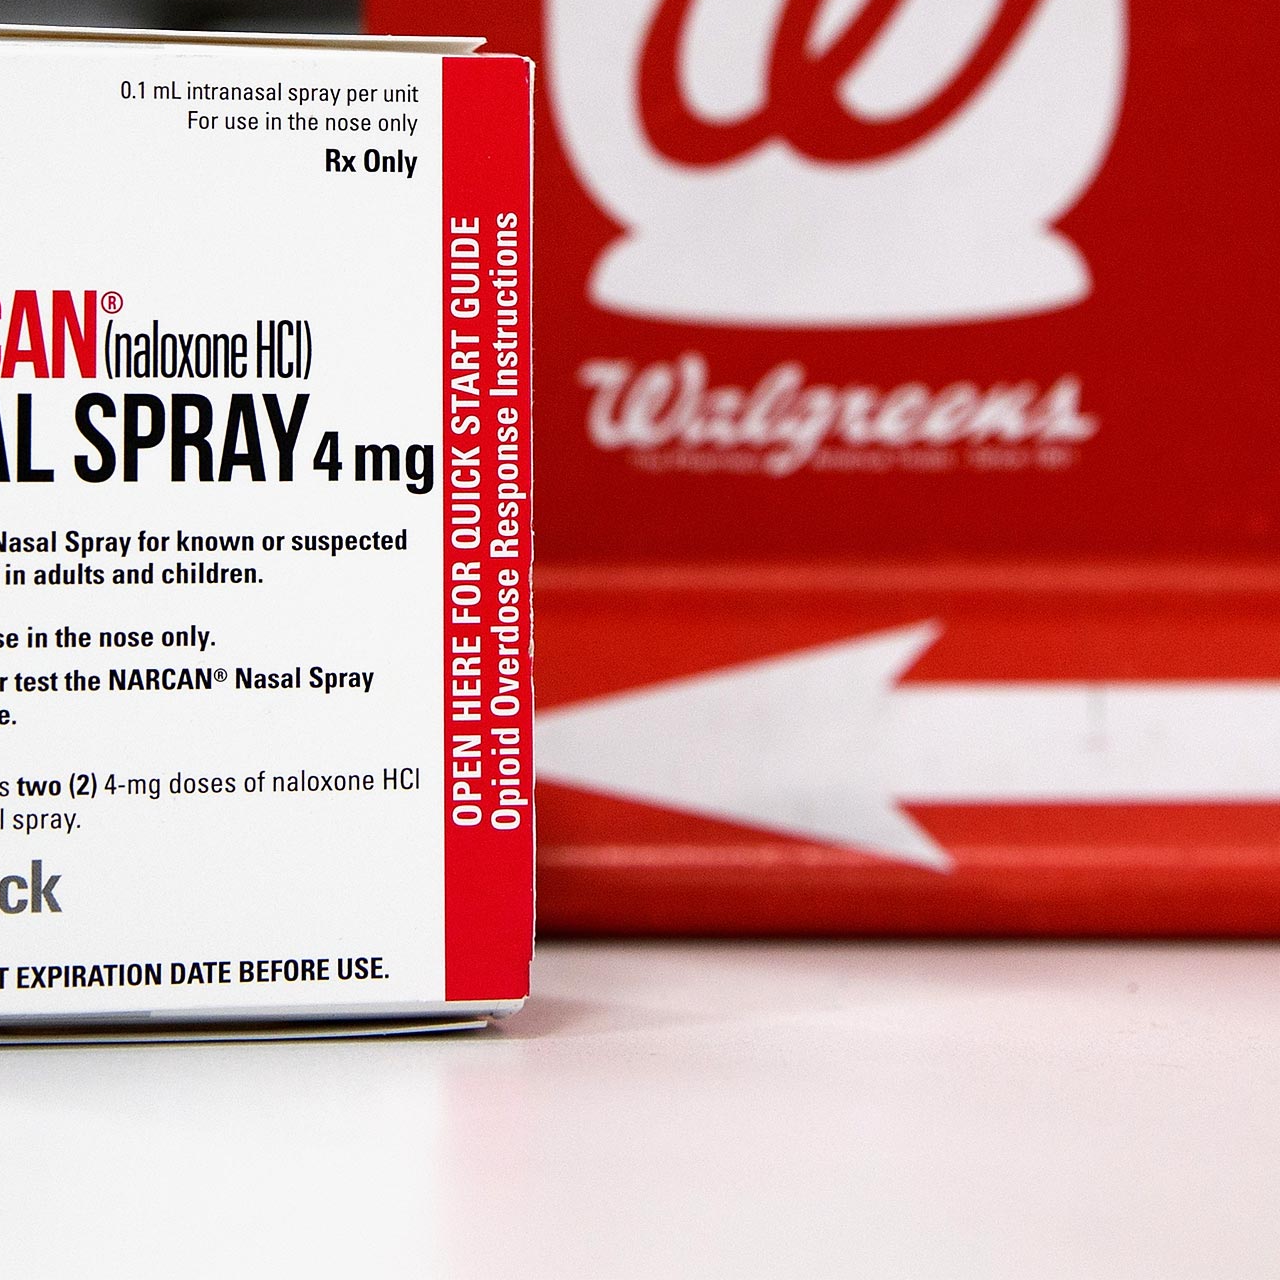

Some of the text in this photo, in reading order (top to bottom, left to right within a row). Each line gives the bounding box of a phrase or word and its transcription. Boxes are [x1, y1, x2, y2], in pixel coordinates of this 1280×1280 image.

[121, 81, 418, 106] 0.1 mL intranasal spray per unit
[188, 111, 417, 136] For use in the nose only
[326, 148, 417, 178] Rx Only
[105, 320, 248, 379] (naloxone
[582, 356, 1095, 474] Walgreens
[74, 393, 310, 483] SPRAY
[313, 431, 342, 482] 4
[355, 442, 434, 495] mg
[451, 218, 482, 825] OPEN HERE FOR QUICK START GUIDE
[489, 212, 528, 830] Opioid Overdose Response Instructions
[65, 530, 131, 558] Spray
[138, 530, 170, 552] for
[177, 530, 254, 551] known
[262, 536, 285, 551] or
[292, 529, 407, 557] suspected
[5, 564, 25, 585] in
[34, 563, 104, 585] adults
[112, 563, 153, 584] and
[162, 562, 263, 584] children.
[27, 626, 47, 648] in
[55, 626, 91, 648] the
[100, 631, 153, 647] nose
[162, 625, 215, 652] only.
[14, 673, 58, 692] test
[64, 670, 100, 691] the
[236, 667, 300, 689] Nasal
[309, 666, 374, 694] Spray
[16, 777, 61, 796] two
[69, 773, 97, 799] (2)
[104, 774, 160, 800] 4-mg
[169, 772, 236, 794] doses
[244, 771, 265, 792] of
[273, 770, 374, 792] naloxone
[13, 813, 80, 835] spray.
[17, 963, 161, 989] EXPIRATION
[171, 961, 231, 985] DATE
[239, 959, 329, 983] BEFORE
[338, 957, 389, 980] USE.
